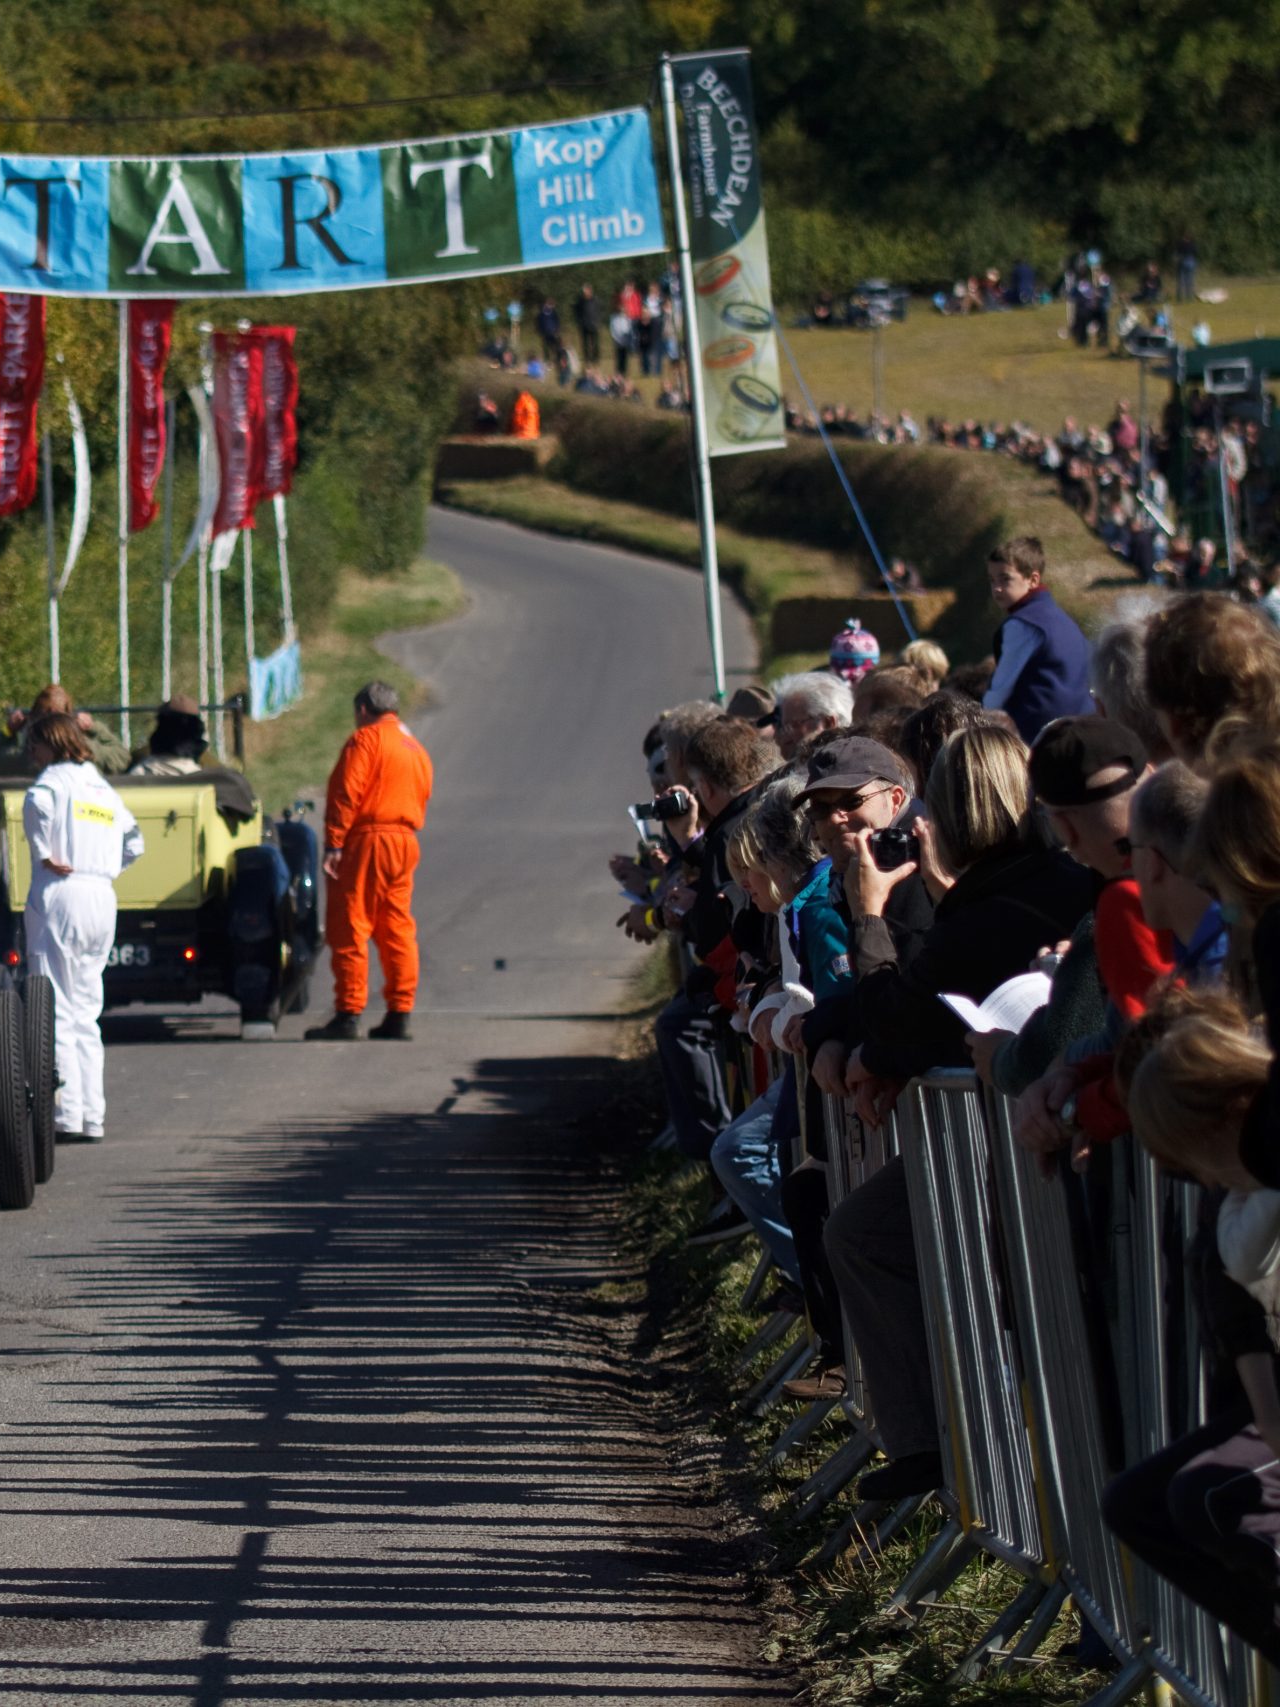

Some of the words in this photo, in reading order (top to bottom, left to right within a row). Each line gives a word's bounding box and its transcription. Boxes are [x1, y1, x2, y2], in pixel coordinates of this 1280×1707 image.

[533, 135, 606, 170] Kop
[696, 66, 753, 228] BEECHDEAN
[696, 102, 718, 196] Farmhouse
[538, 173, 595, 208] Hill
[541, 207, 645, 248] Climb
